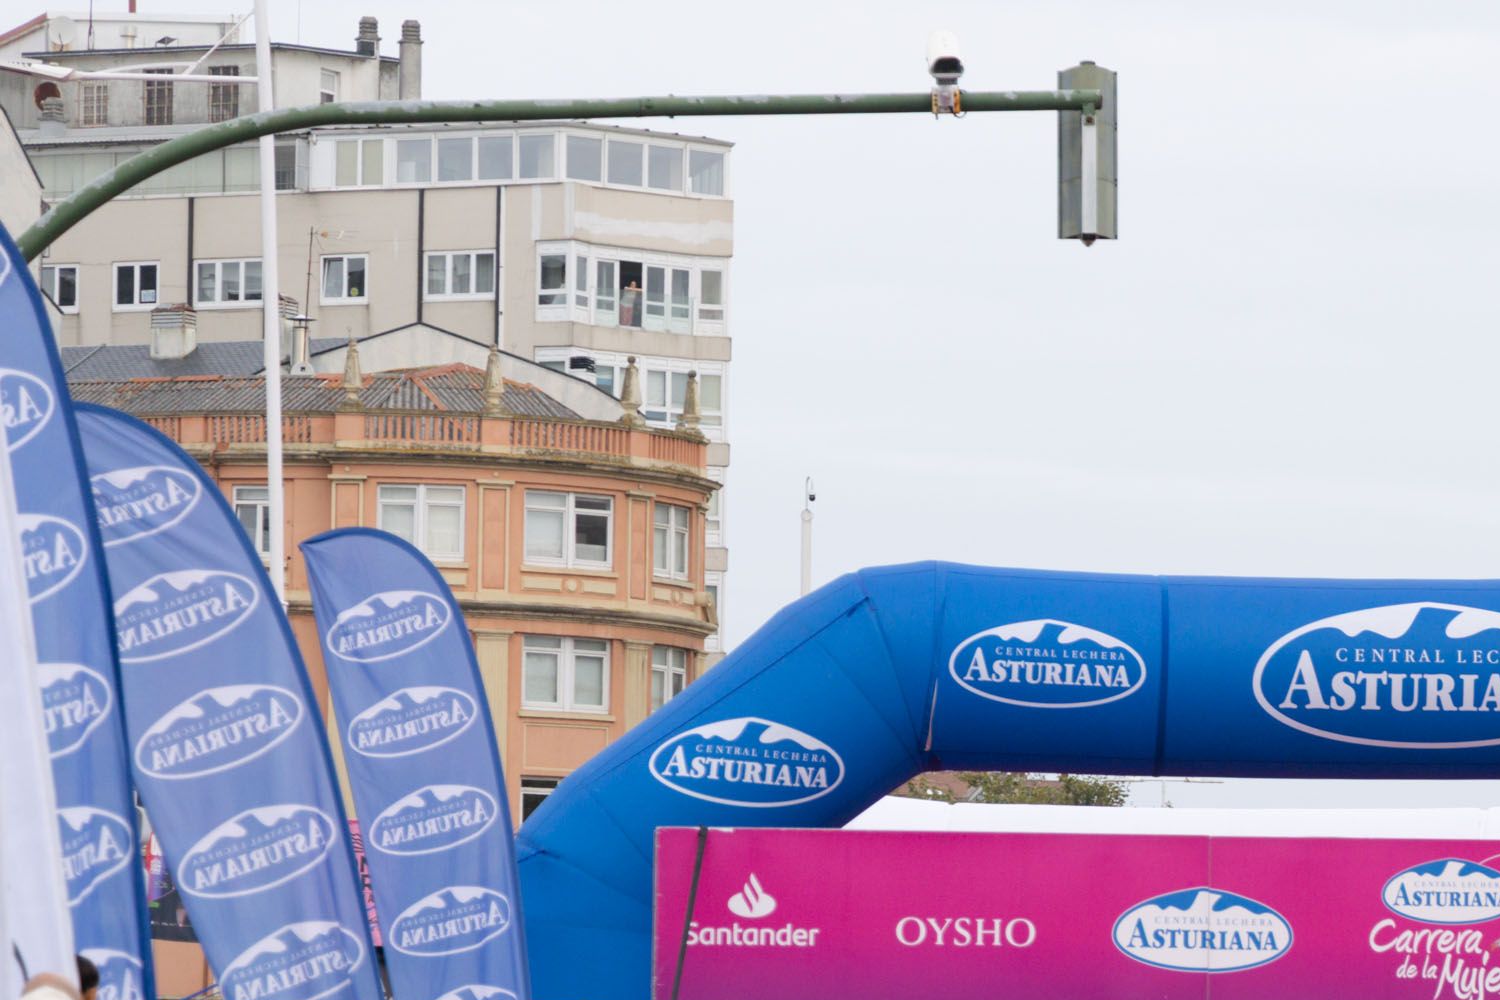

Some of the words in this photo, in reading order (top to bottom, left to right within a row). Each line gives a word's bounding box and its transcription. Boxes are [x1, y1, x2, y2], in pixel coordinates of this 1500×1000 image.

[963, 647, 1131, 687] ASTURIANA
[995, 646, 1057, 658] CENTRAL
[1063, 650, 1126, 661] LECHERA
[1336, 647, 1445, 663] CENTRAL
[661, 745, 828, 788] ASTURIANA
[696, 744, 758, 757] CENTRAL
[763, 749, 828, 764] LECHERA
[686, 922, 820, 946] Santander
[895, 916, 1037, 947] OYSHO
[1127, 917, 1279, 951] ASTURIANA
[1154, 916, 1210, 925] CENTRAL
[1216, 918, 1274, 927] LECHERA
[1369, 918, 1484, 954] Carrera
[1396, 954, 1418, 979] de
[1422, 953, 1438, 980] la
